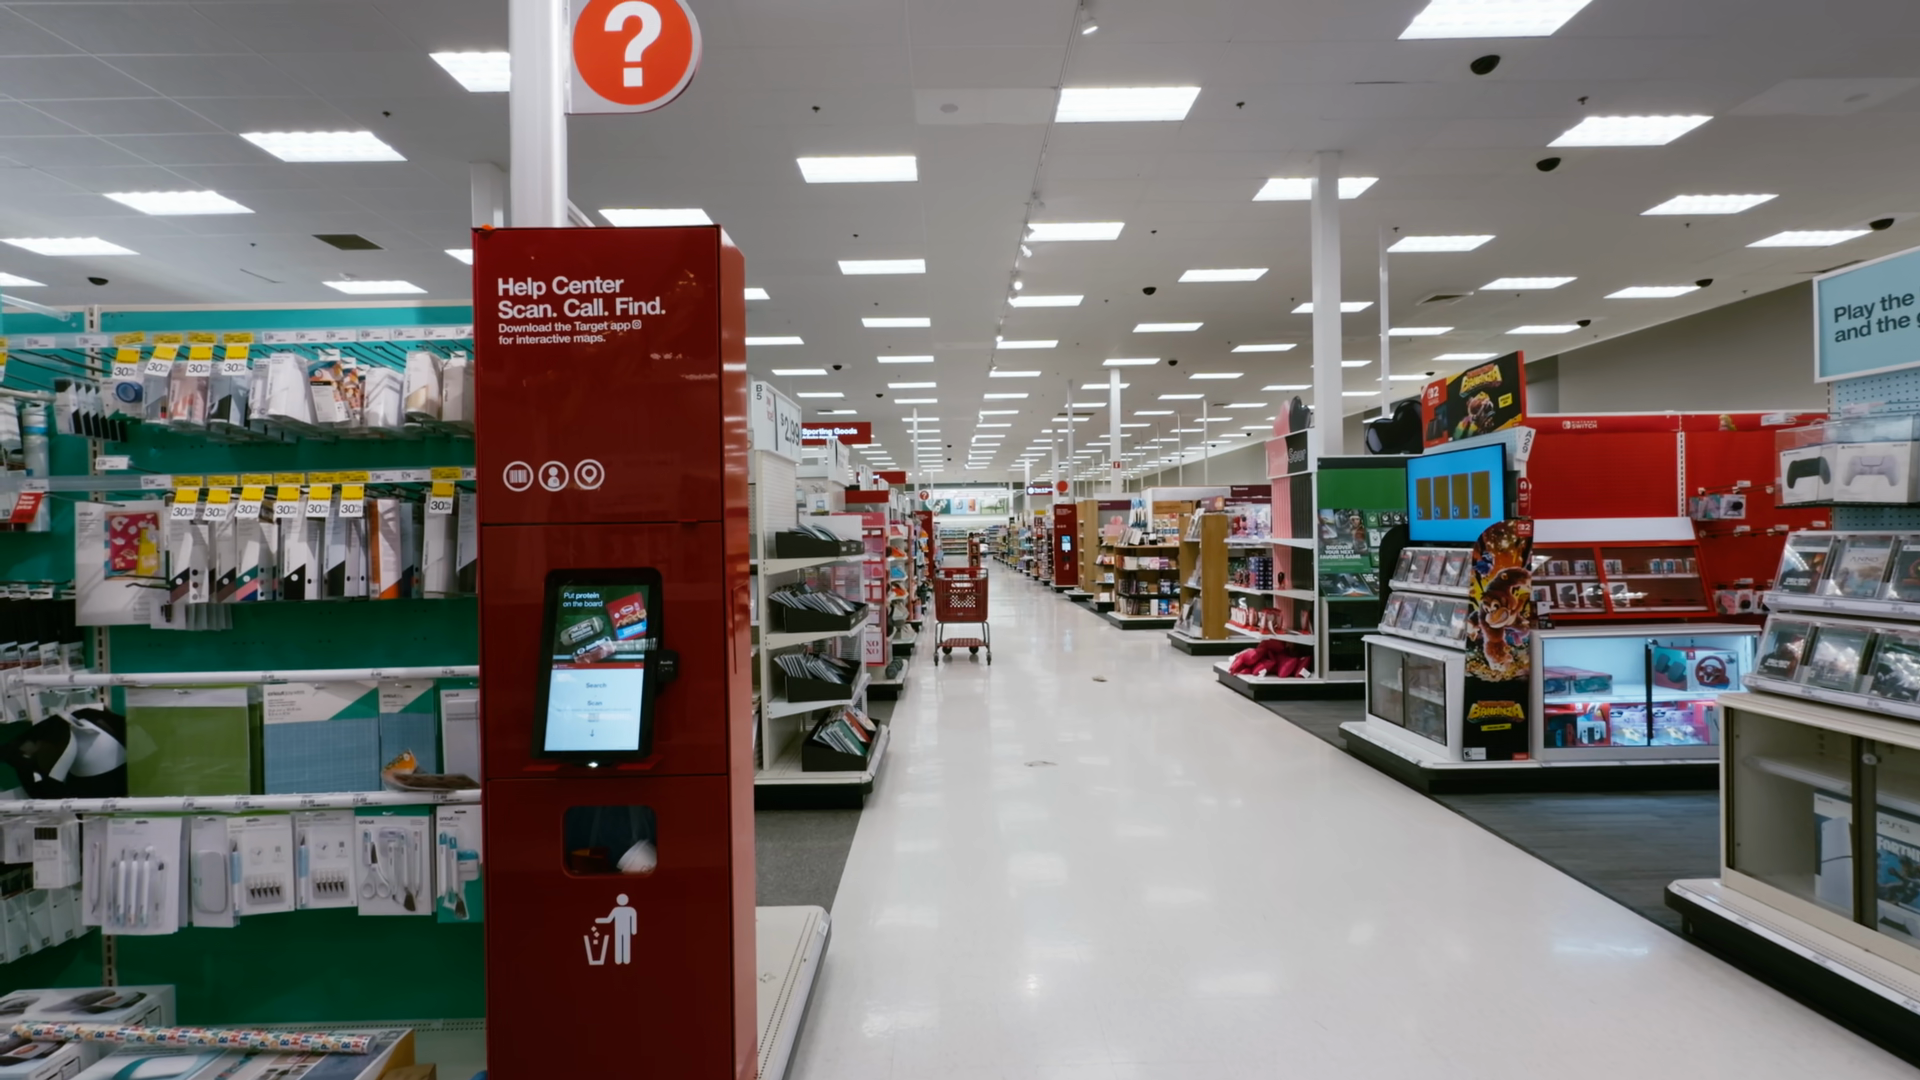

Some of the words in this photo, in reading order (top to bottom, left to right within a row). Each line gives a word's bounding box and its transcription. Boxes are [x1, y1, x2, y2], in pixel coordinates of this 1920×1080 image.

[498, 277, 546, 299] Help
[552, 276, 624, 294] Center
[498, 300, 558, 319] Scan.
[563, 298, 609, 317] Call.
[615, 296, 666, 316] Find.
[1834, 302, 1875, 323] Play
[1879, 293, 1915, 312] the
[498, 322, 551, 333] Download
[554, 322, 571, 332] the
[574, 321, 608, 333] Target
[610, 321, 631, 332] app
[1835, 320, 1872, 343] and
[1876, 315, 1911, 333] the
[498, 335, 513, 345] for
[516, 333, 570, 345] interactive
[573, 334, 606, 345] maps.
[114, 366, 129, 377] 30
[147, 362, 163, 373] 30
[188, 363, 203, 373] 30
[224, 363, 238, 373] 30
[802, 428, 832, 436] Sporting
[834, 427, 858, 435] Goods
[238, 504, 252, 514] 30
[276, 505, 290, 515] 30
[307, 504, 322, 514] 30
[341, 504, 355, 514] 30
[430, 500, 444, 511] 30
[172, 507, 187, 517] 30
[205, 507, 220, 517] 30
[575, 592, 600, 600] protein
[1467, 703, 1525, 719] BANANZA
[1880, 819, 1910, 834] PS5
